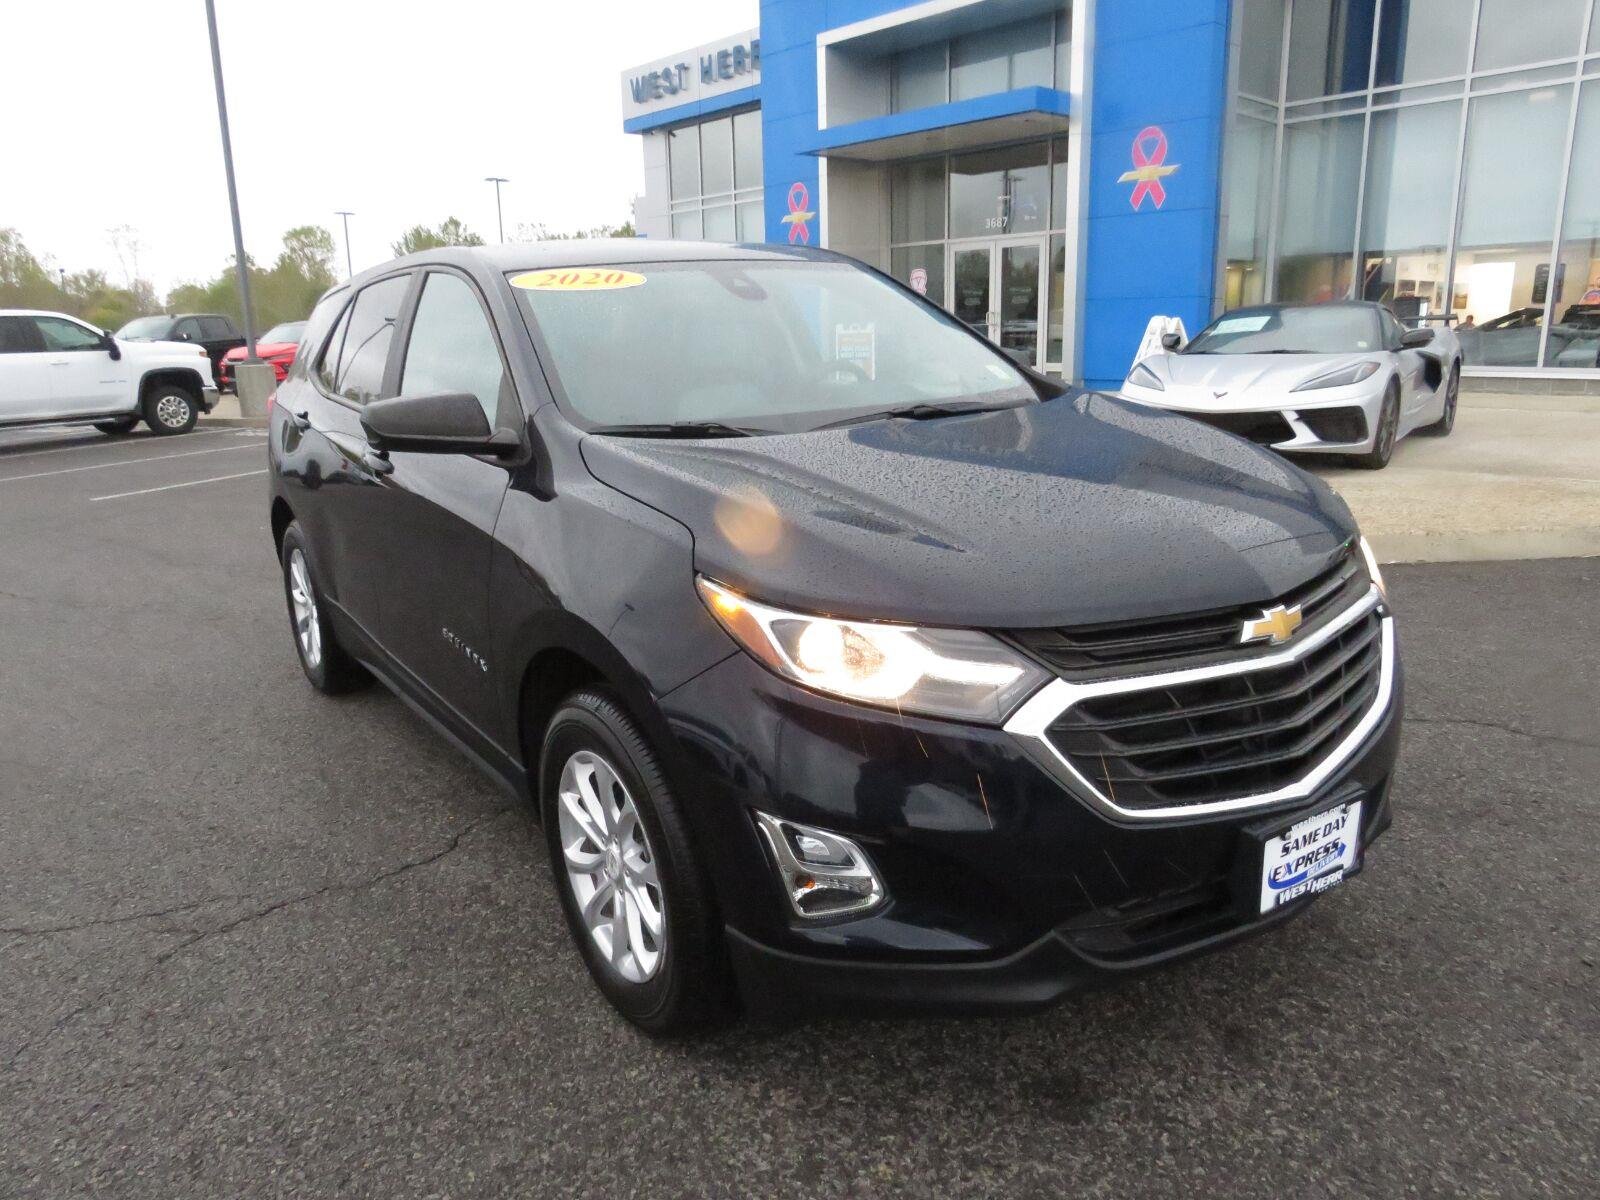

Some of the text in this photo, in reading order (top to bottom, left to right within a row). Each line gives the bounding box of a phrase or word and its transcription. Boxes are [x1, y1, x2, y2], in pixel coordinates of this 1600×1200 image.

[629, 62, 688, 104] WEST
[537, 272, 625, 287] 2020
[1280, 814, 1349, 858] SAME DAY
[1272, 837, 1341, 882] EXPRESS
